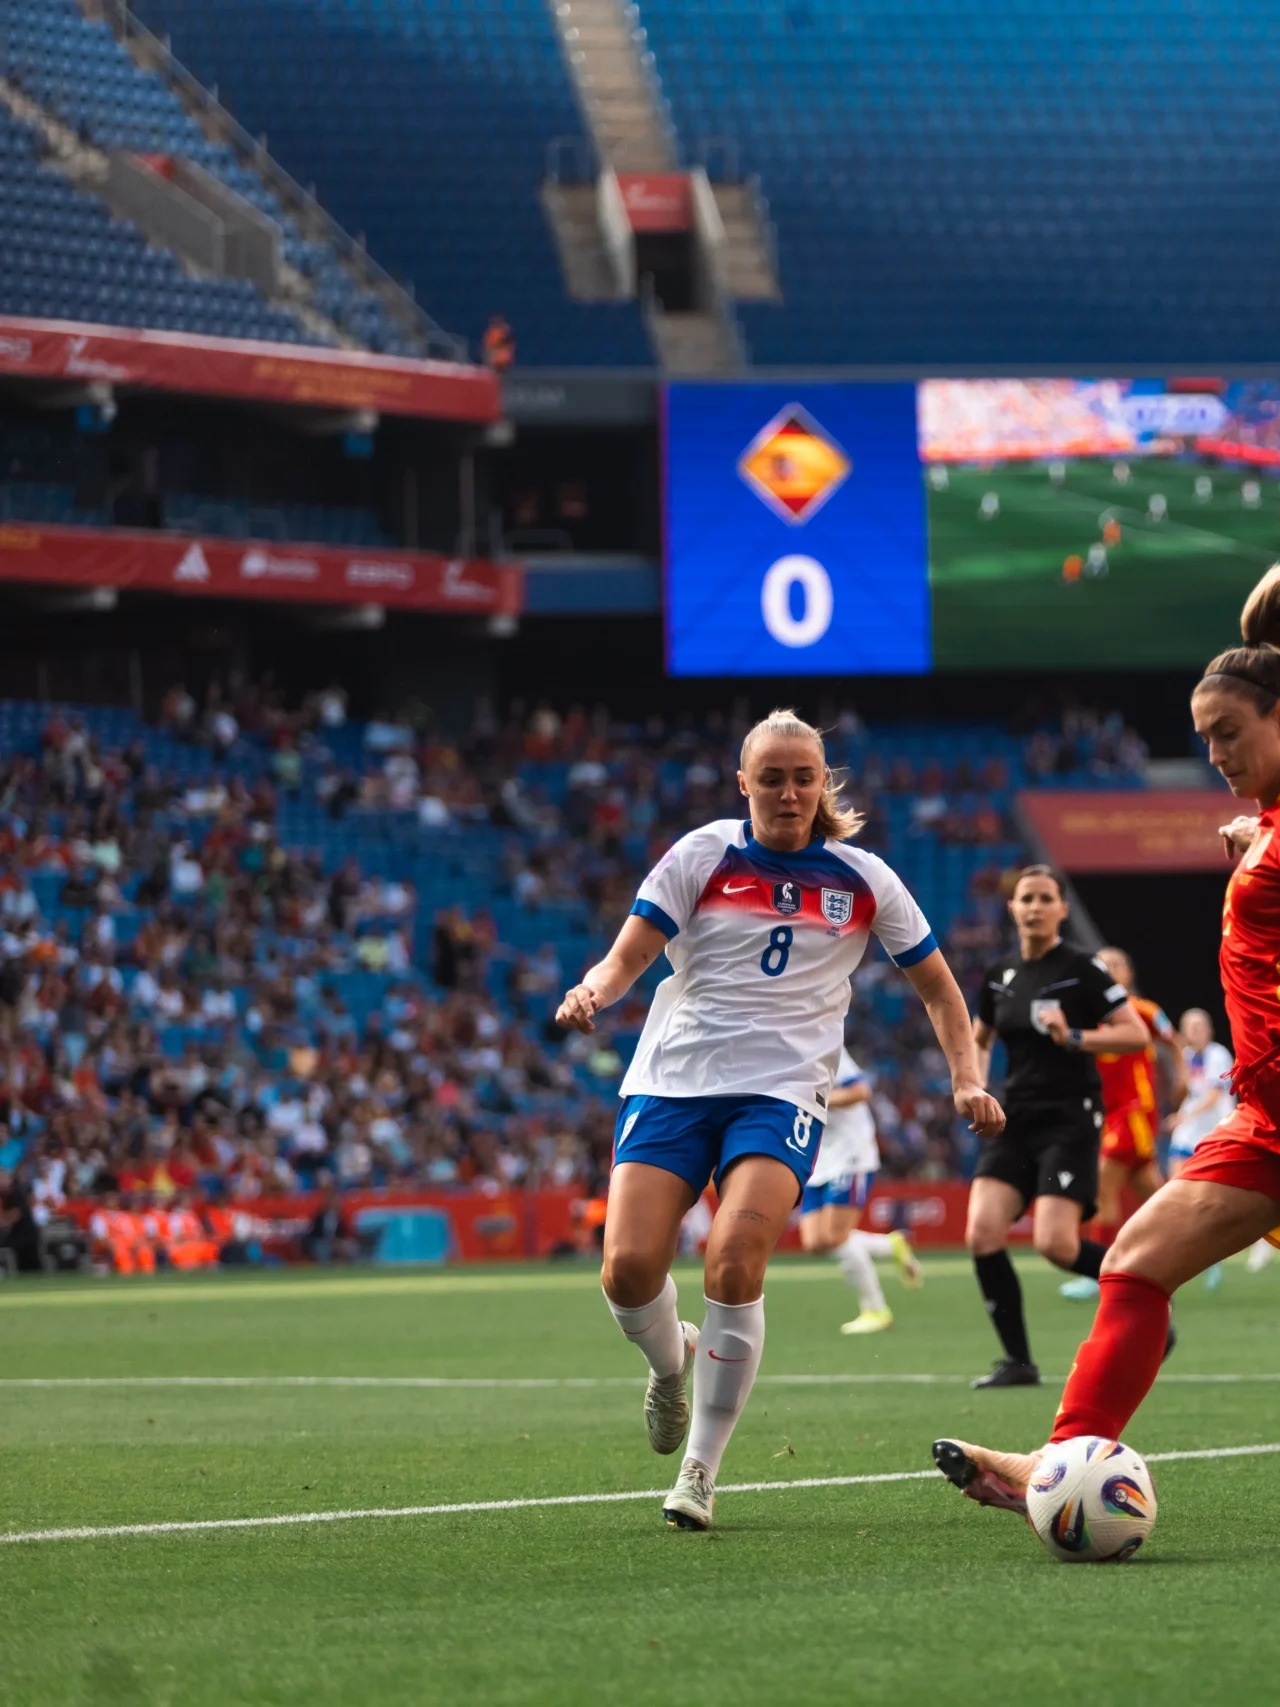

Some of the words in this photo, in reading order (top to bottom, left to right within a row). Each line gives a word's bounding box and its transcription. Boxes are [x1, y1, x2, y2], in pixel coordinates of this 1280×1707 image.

[761, 554, 834, 647] 0
[760, 925, 793, 977] 8
[793, 1107, 813, 1149] 8
